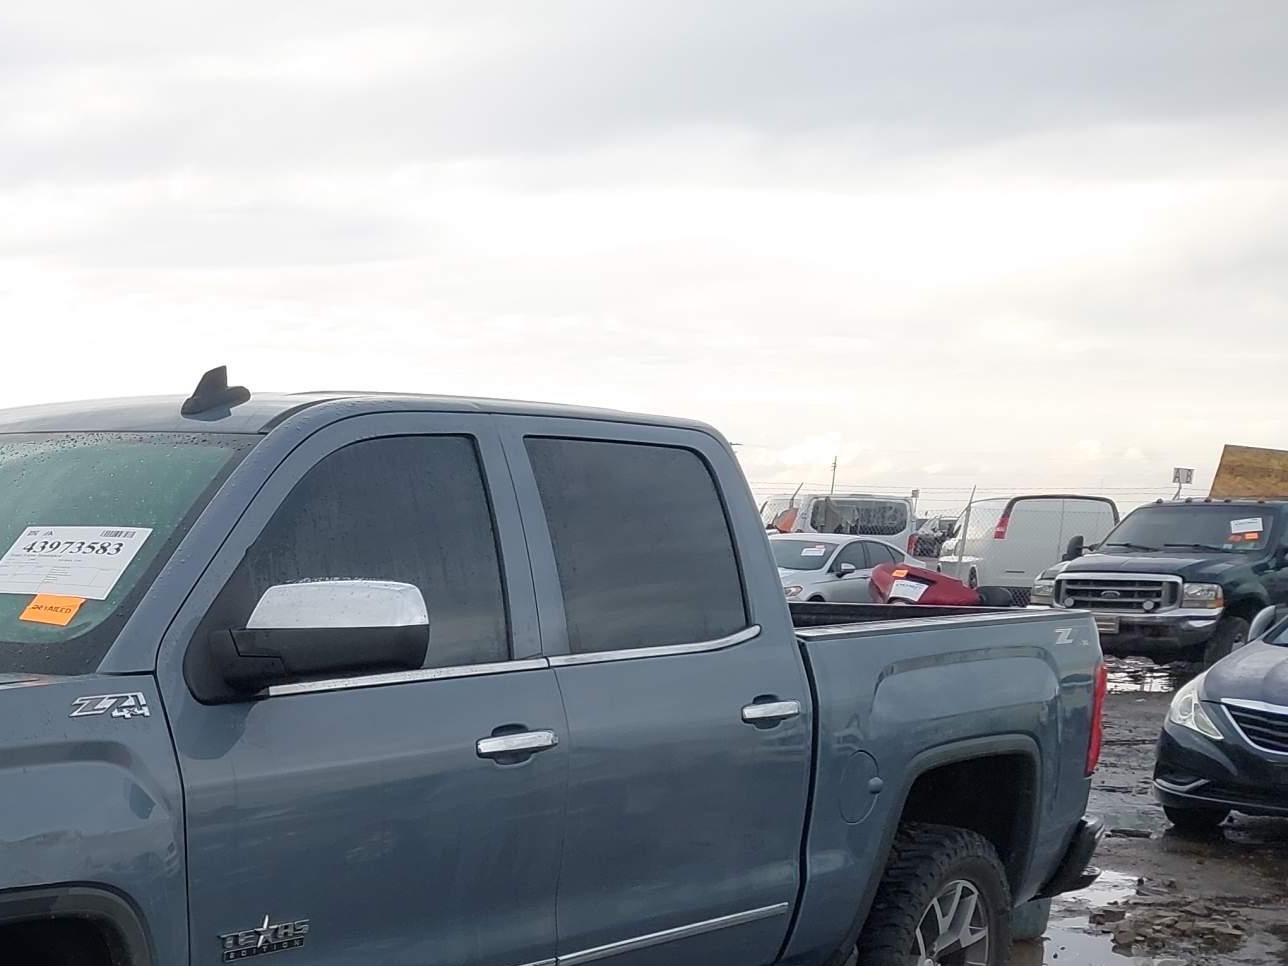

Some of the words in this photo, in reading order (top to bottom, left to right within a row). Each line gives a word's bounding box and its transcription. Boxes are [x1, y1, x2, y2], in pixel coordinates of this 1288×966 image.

[22, 540, 124, 556] 43973583
[69, 692, 147, 717] Z71
[220, 914, 310, 949] TEXAS
[229, 940, 301, 959] EDITION
